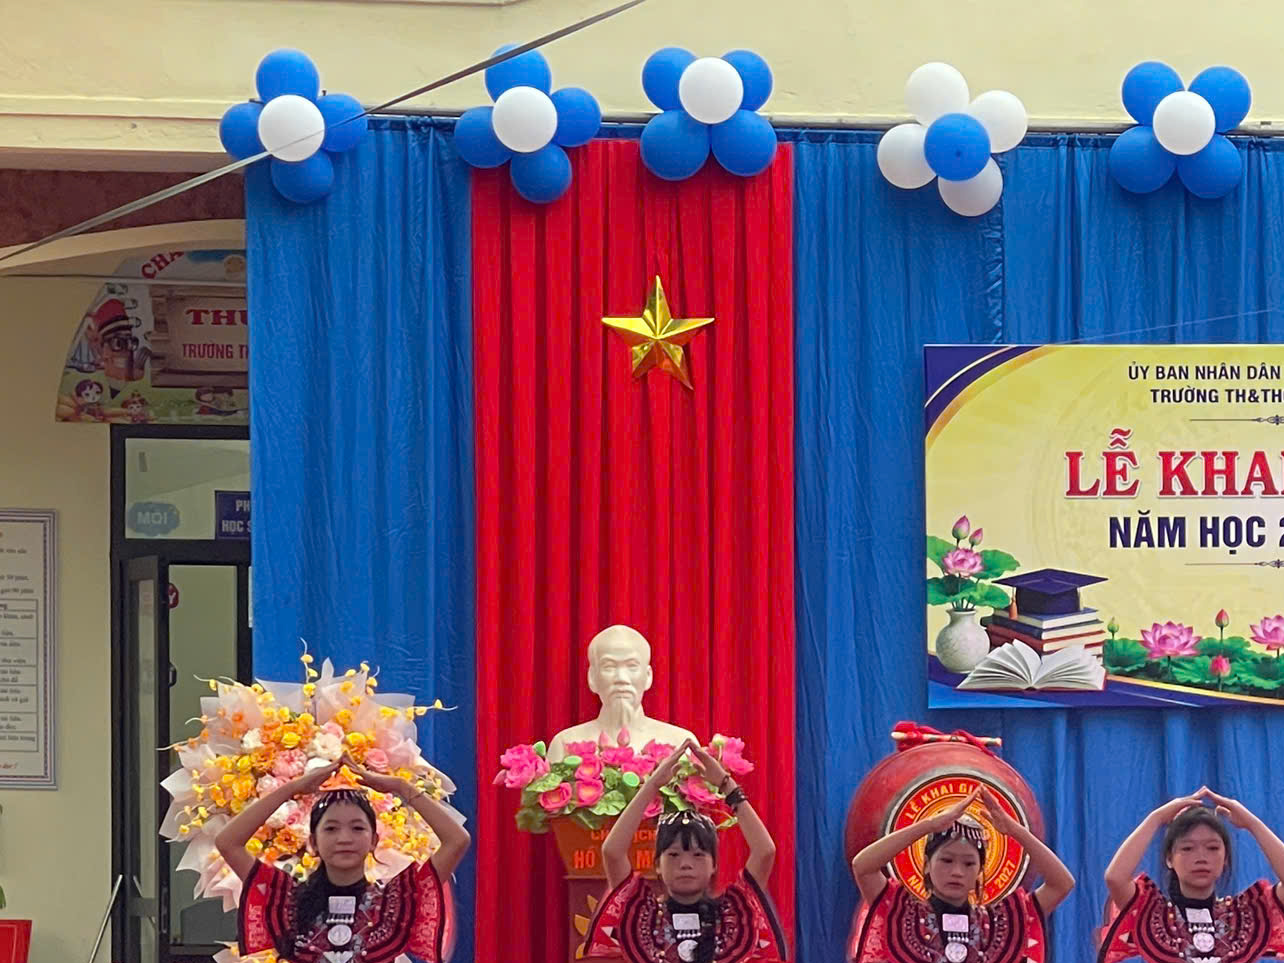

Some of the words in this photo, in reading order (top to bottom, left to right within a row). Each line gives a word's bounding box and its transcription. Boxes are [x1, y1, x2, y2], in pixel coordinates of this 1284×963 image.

[1128, 361, 1150, 380] ỦY
[1155, 365, 1189, 380] BAN
[1195, 362, 1240, 380] NHÂN
[1247, 362, 1281, 380] DÂN
[1150, 385, 1219, 403] TRƯỜNG
[1064, 428, 1140, 497] LỄ
[1109, 510, 1187, 548] NĂM
[1200, 516, 1266, 555] HỌC
[921, 783, 954, 804] KHAI
[994, 860, 1016, 888] 2027
